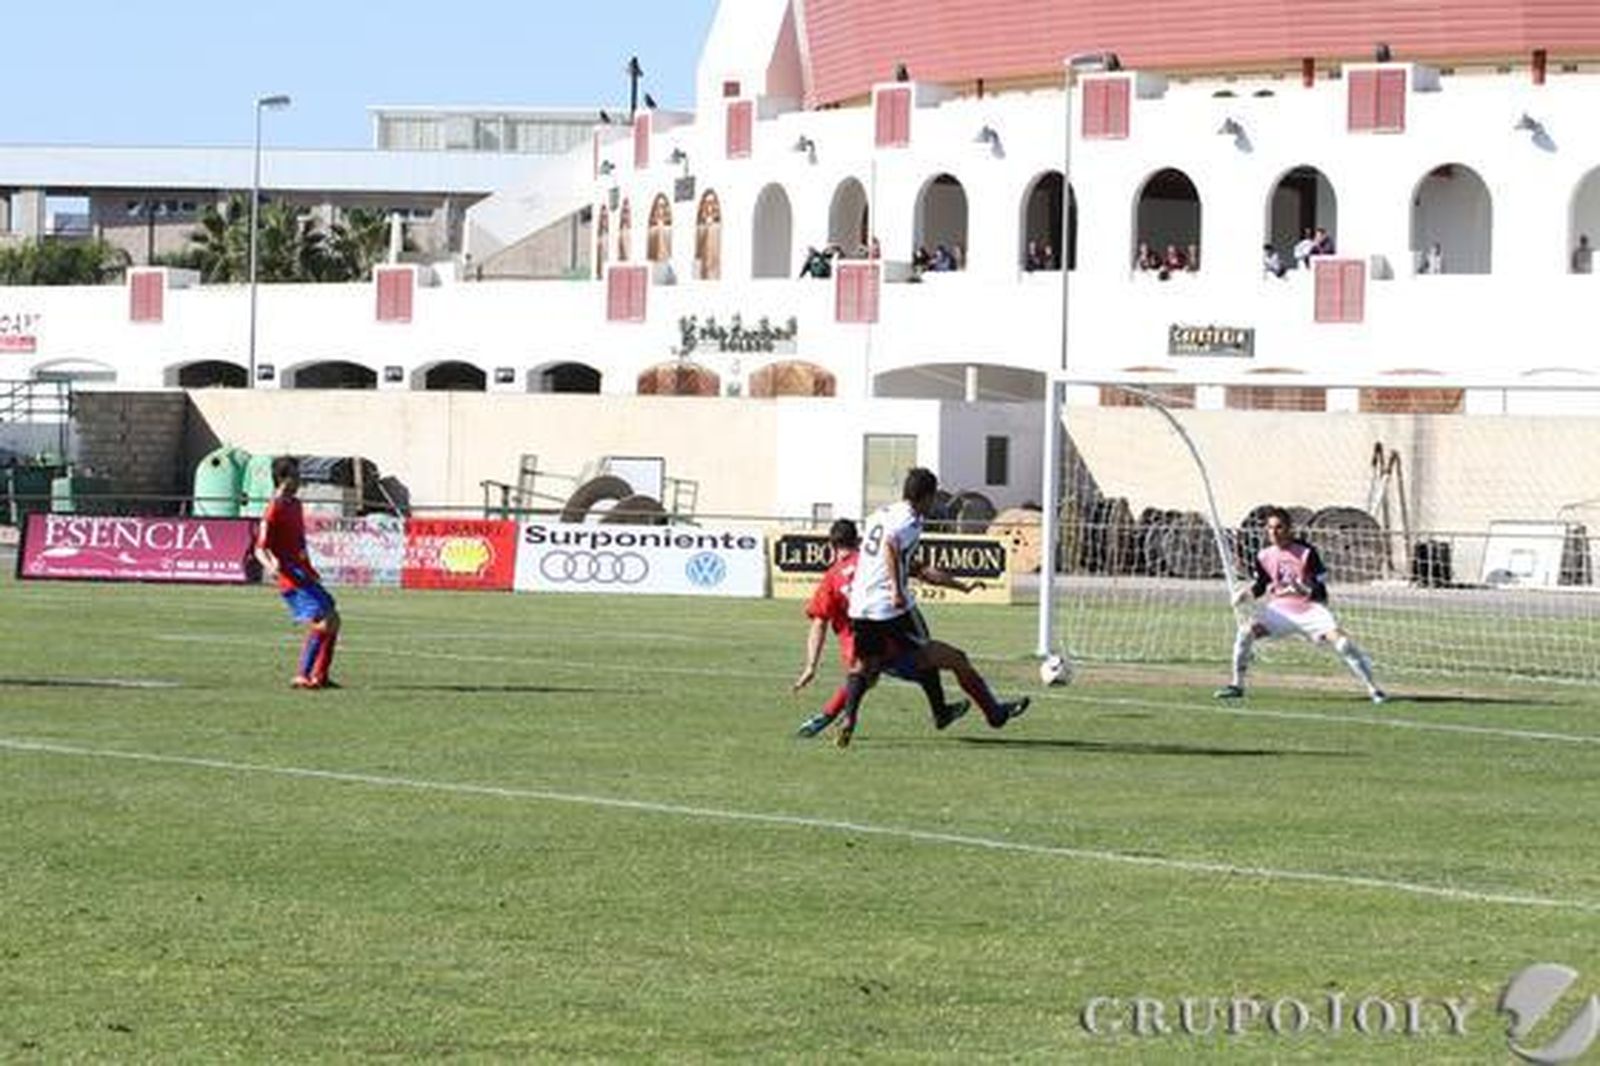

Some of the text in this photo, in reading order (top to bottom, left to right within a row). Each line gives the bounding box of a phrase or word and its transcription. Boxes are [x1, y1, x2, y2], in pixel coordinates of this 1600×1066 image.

[45, 520, 213, 549] ESENCIA
[525, 525, 757, 549] Surponiente
[864, 524, 884, 556] 9
[780, 543, 799, 565] La
[807, 542, 835, 566] BO
[928, 546, 1000, 571] JAMON
